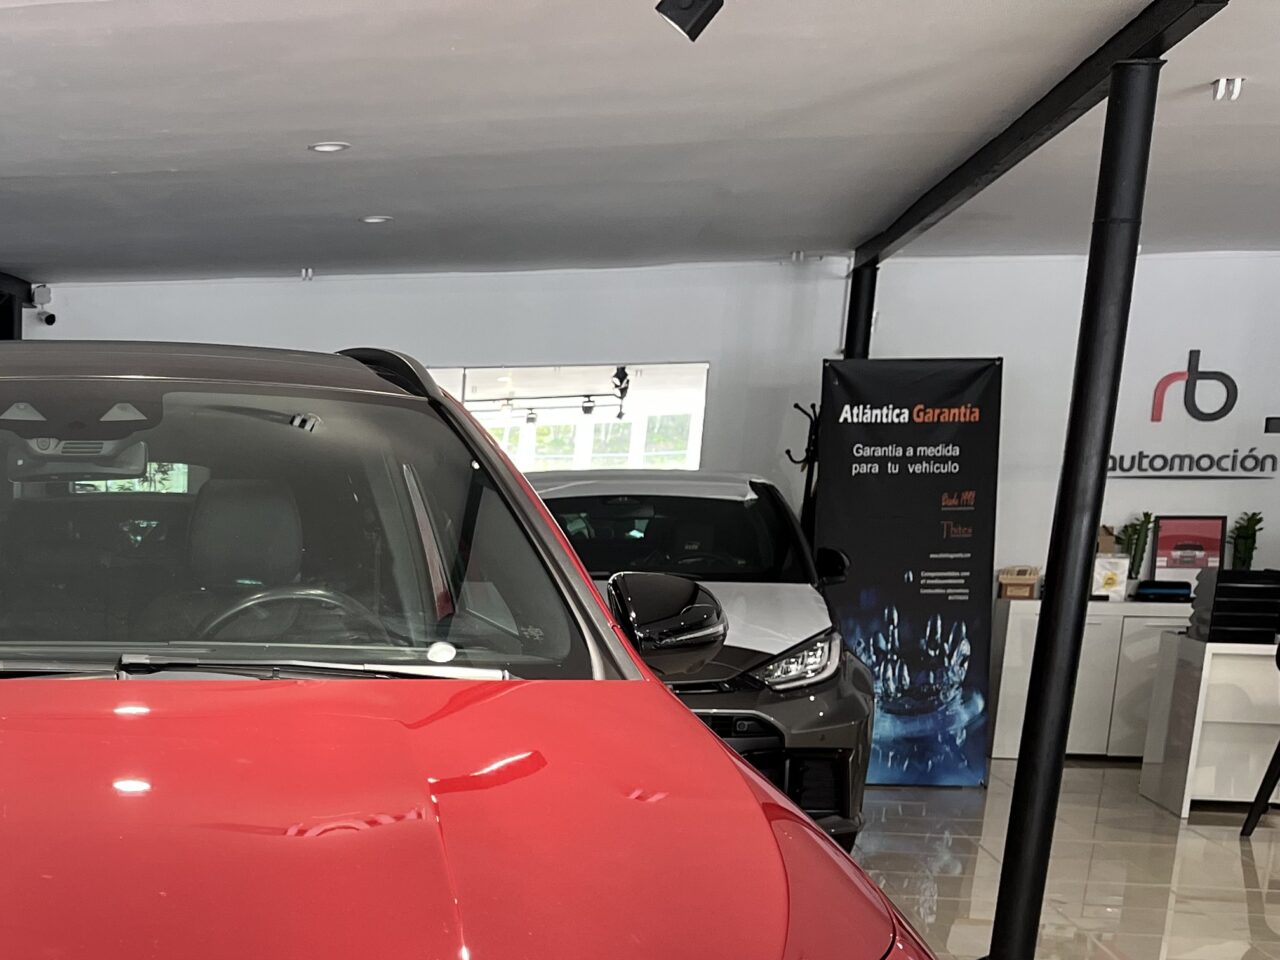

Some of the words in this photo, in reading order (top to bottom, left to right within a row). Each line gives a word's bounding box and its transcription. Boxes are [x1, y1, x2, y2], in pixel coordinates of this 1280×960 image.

[1151, 349, 1238, 422] rb
[838, 403, 909, 423] Atlántica
[906, 446, 914, 457] a
[916, 443, 960, 457] medida
[852, 462, 879, 476] para
[887, 461, 899, 474] tu
